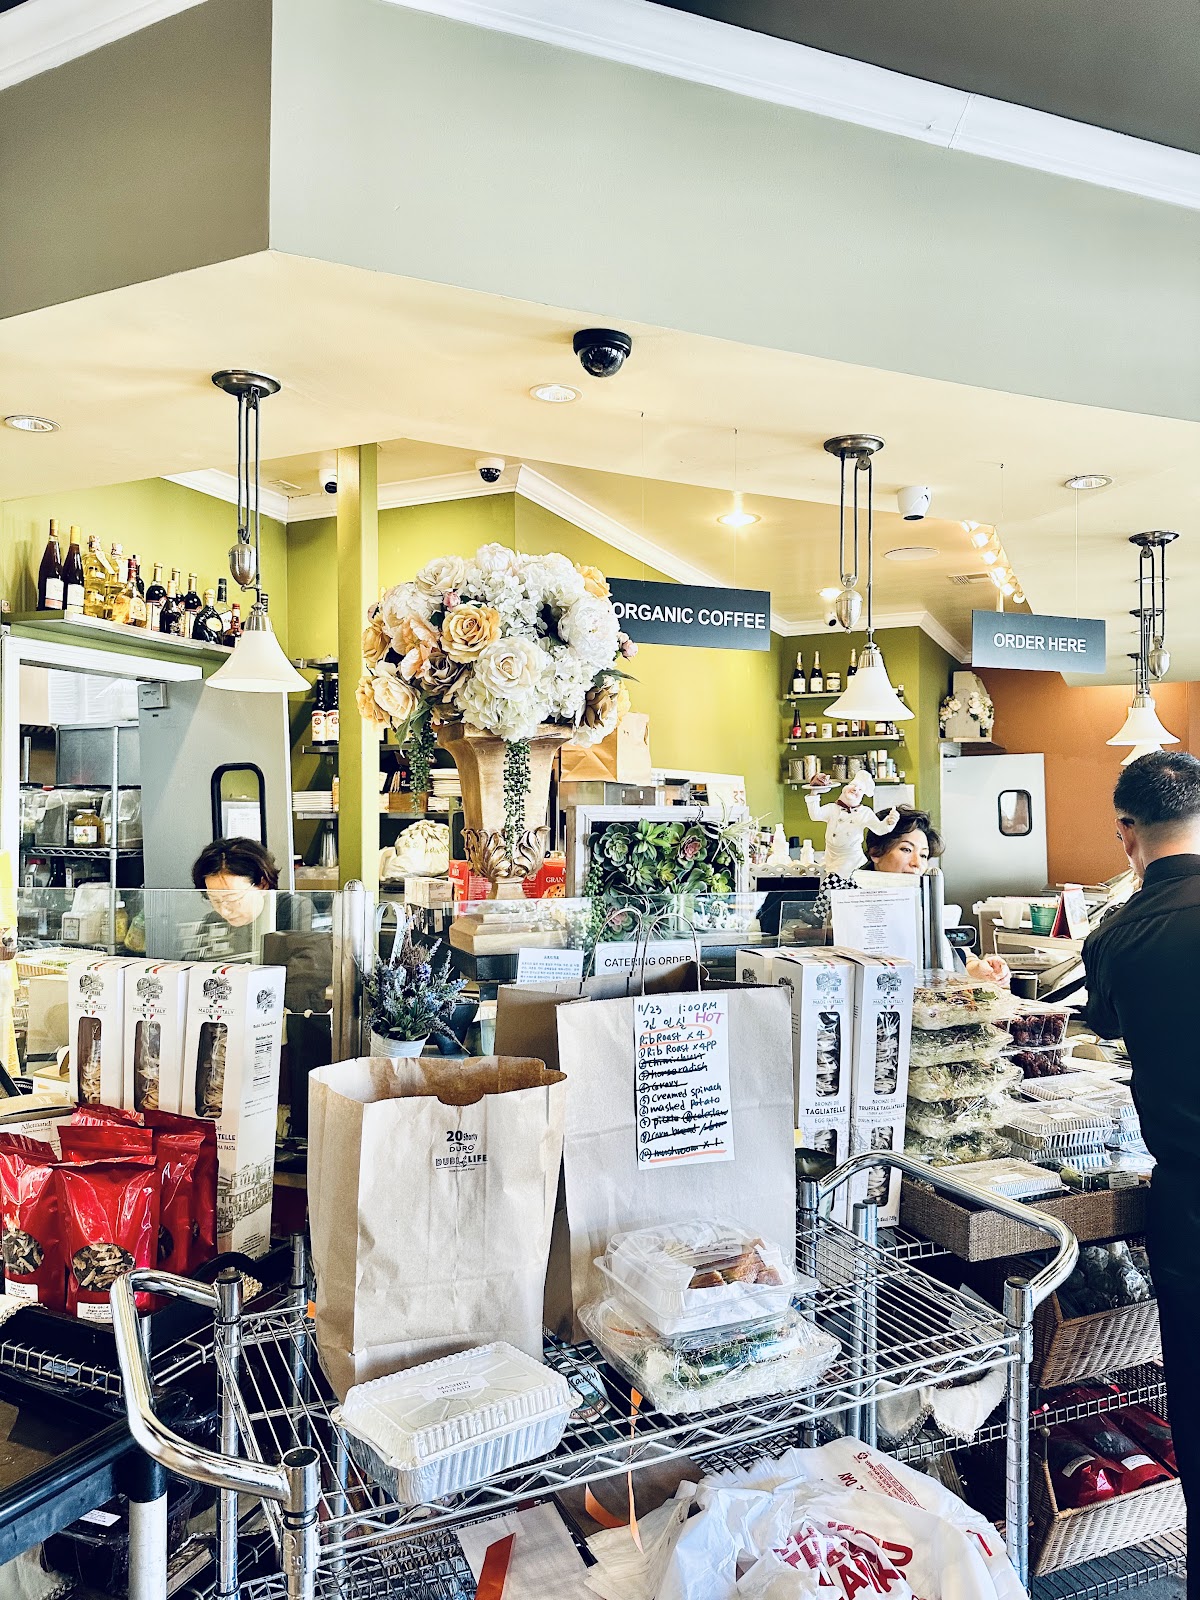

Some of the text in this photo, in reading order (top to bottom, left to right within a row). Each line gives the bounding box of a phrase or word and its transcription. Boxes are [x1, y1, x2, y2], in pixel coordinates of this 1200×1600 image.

[612, 601, 766, 630] ORGANIC COFFEE
[993, 632, 1087, 653] ORDER HERE
[604, 956, 656, 967] CATERING
[637, 1002, 662, 1015] 11/23
[695, 1011, 724, 1025] HOT
[639, 1032, 655, 1046] Rib
[656, 1031, 681, 1043] Roast
[696, 1030, 706, 1040] 4
[647, 1044, 663, 1058] Rib
[666, 1043, 690, 1055] Roast
[805, 1106, 847, 1115] TAGLIATELLE
[880, 1102, 905, 1110] TAGLIATELLE
[446, 1130, 463, 1142] 20
[449, 1144, 475, 1153] DURO
[467, 1154, 488, 1163] LIFE
[838, 1472, 858, 1487] DAY
